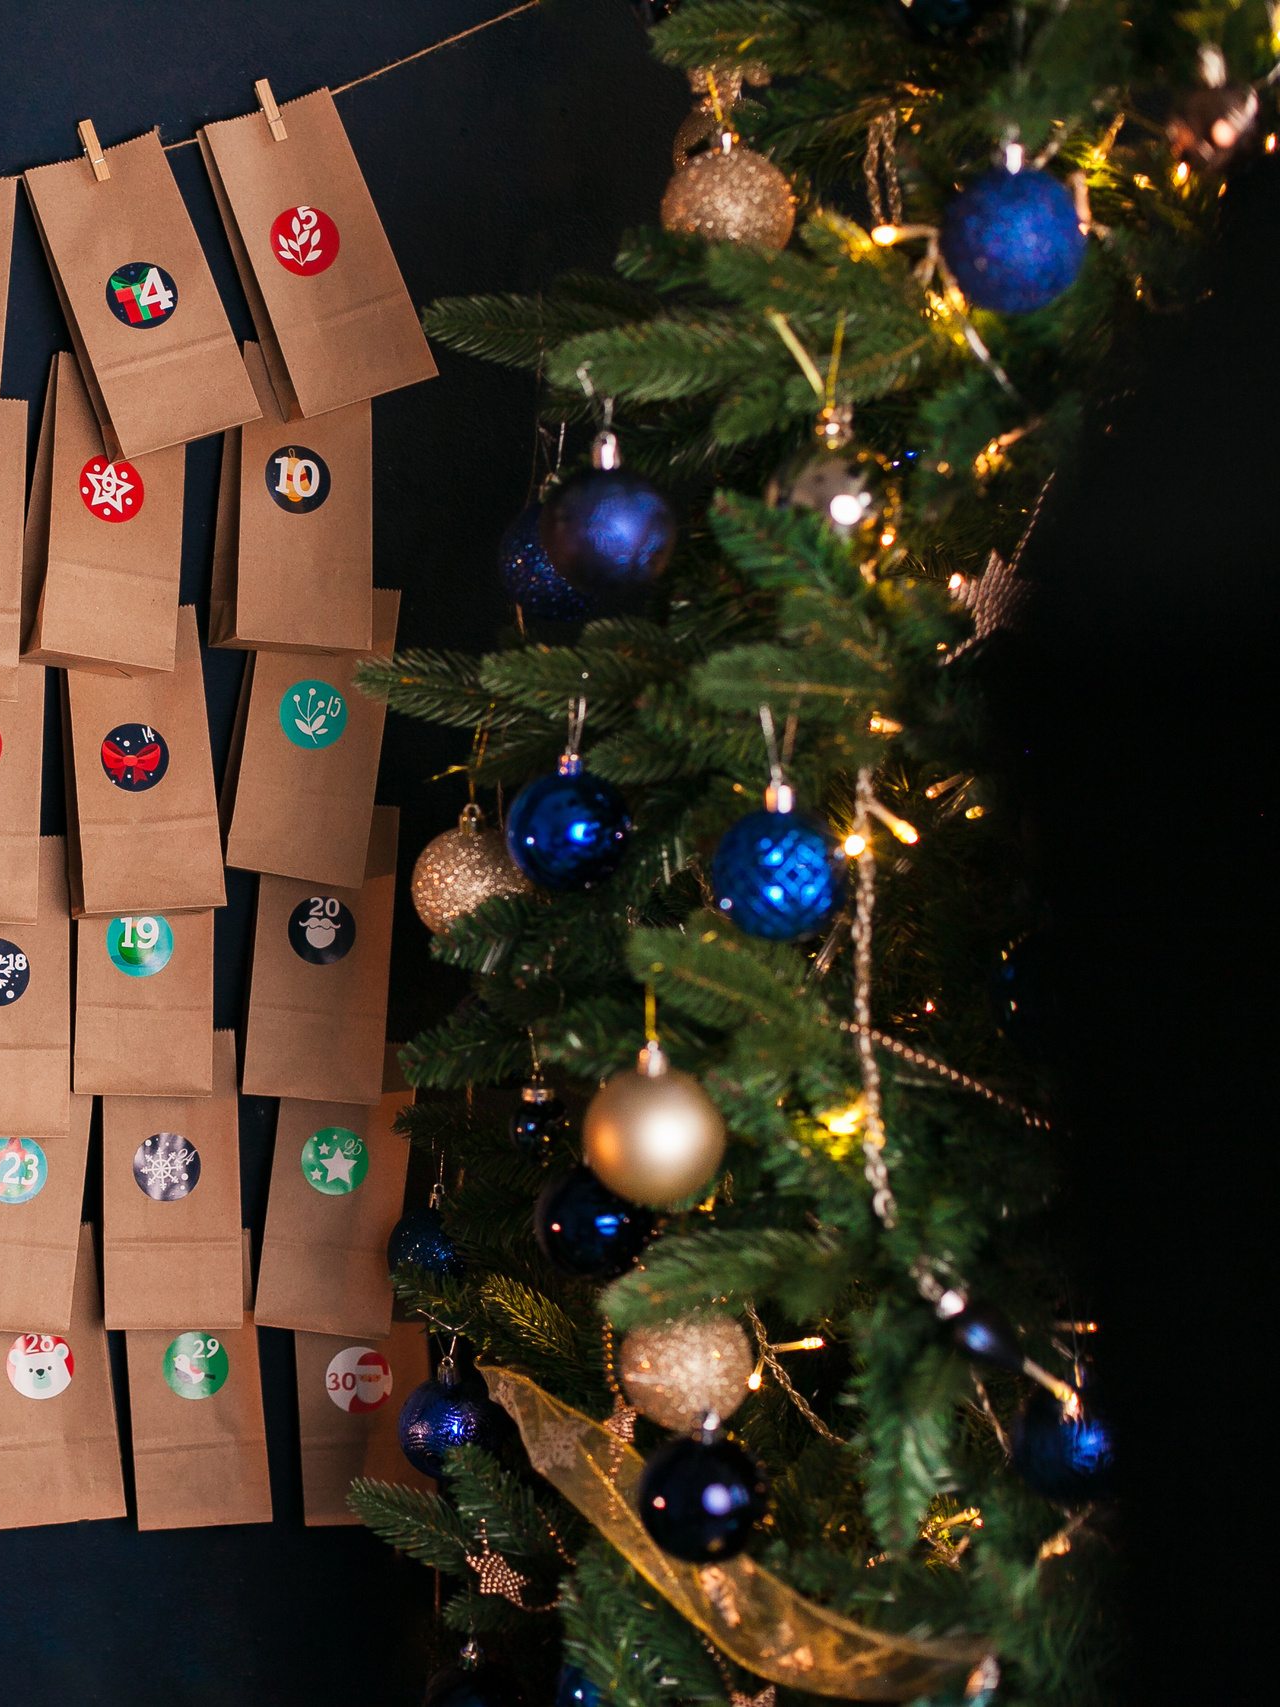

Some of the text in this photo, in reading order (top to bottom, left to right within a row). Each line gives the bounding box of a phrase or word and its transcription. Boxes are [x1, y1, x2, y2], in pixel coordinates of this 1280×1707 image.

[297, 206, 318, 230] 5
[139, 267, 173, 310] 4
[101, 476, 117, 498] 9
[275, 456, 320, 498] 10
[326, 695, 341, 718] 15
[141, 725, 155, 743] 14
[308, 896, 340, 918] 20
[120, 916, 160, 949] 19
[6, 953, 27, 971] 18
[175, 1148, 198, 1165] 24
[343, 1138, 363, 1156] 25
[2, 1152, 39, 1187] 23
[25, 1333, 55, 1354] 28
[192, 1338, 220, 1359] 29
[327, 1372, 357, 1391] 30
